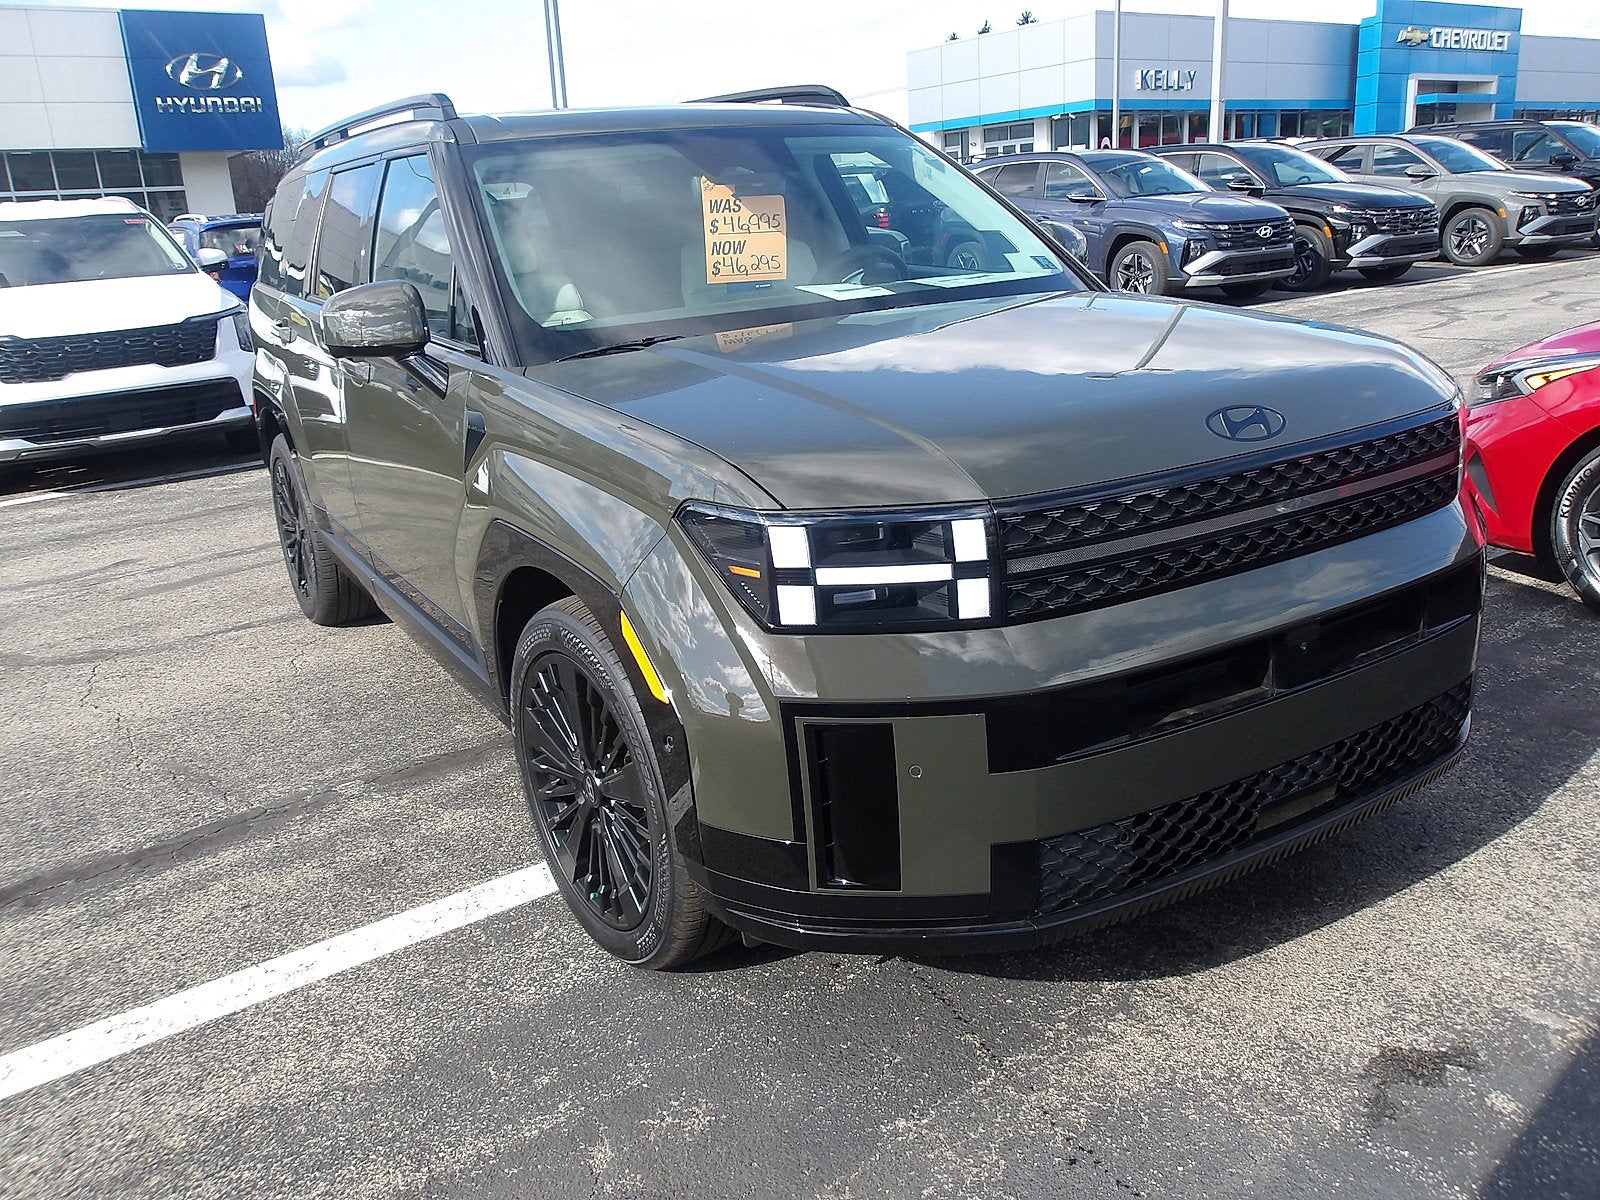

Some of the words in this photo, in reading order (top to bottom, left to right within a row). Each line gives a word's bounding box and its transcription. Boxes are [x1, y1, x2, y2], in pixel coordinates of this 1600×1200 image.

[1431, 27, 1511, 51] CHEVROLET
[1138, 69, 1197, 90] KELLY
[156, 97, 263, 113] HYUNDAI
[709, 198, 742, 214] WAS
[711, 240, 746, 256] NOW
[711, 255, 781, 277] $46,295
[1560, 467, 1593, 518] KUMHO
